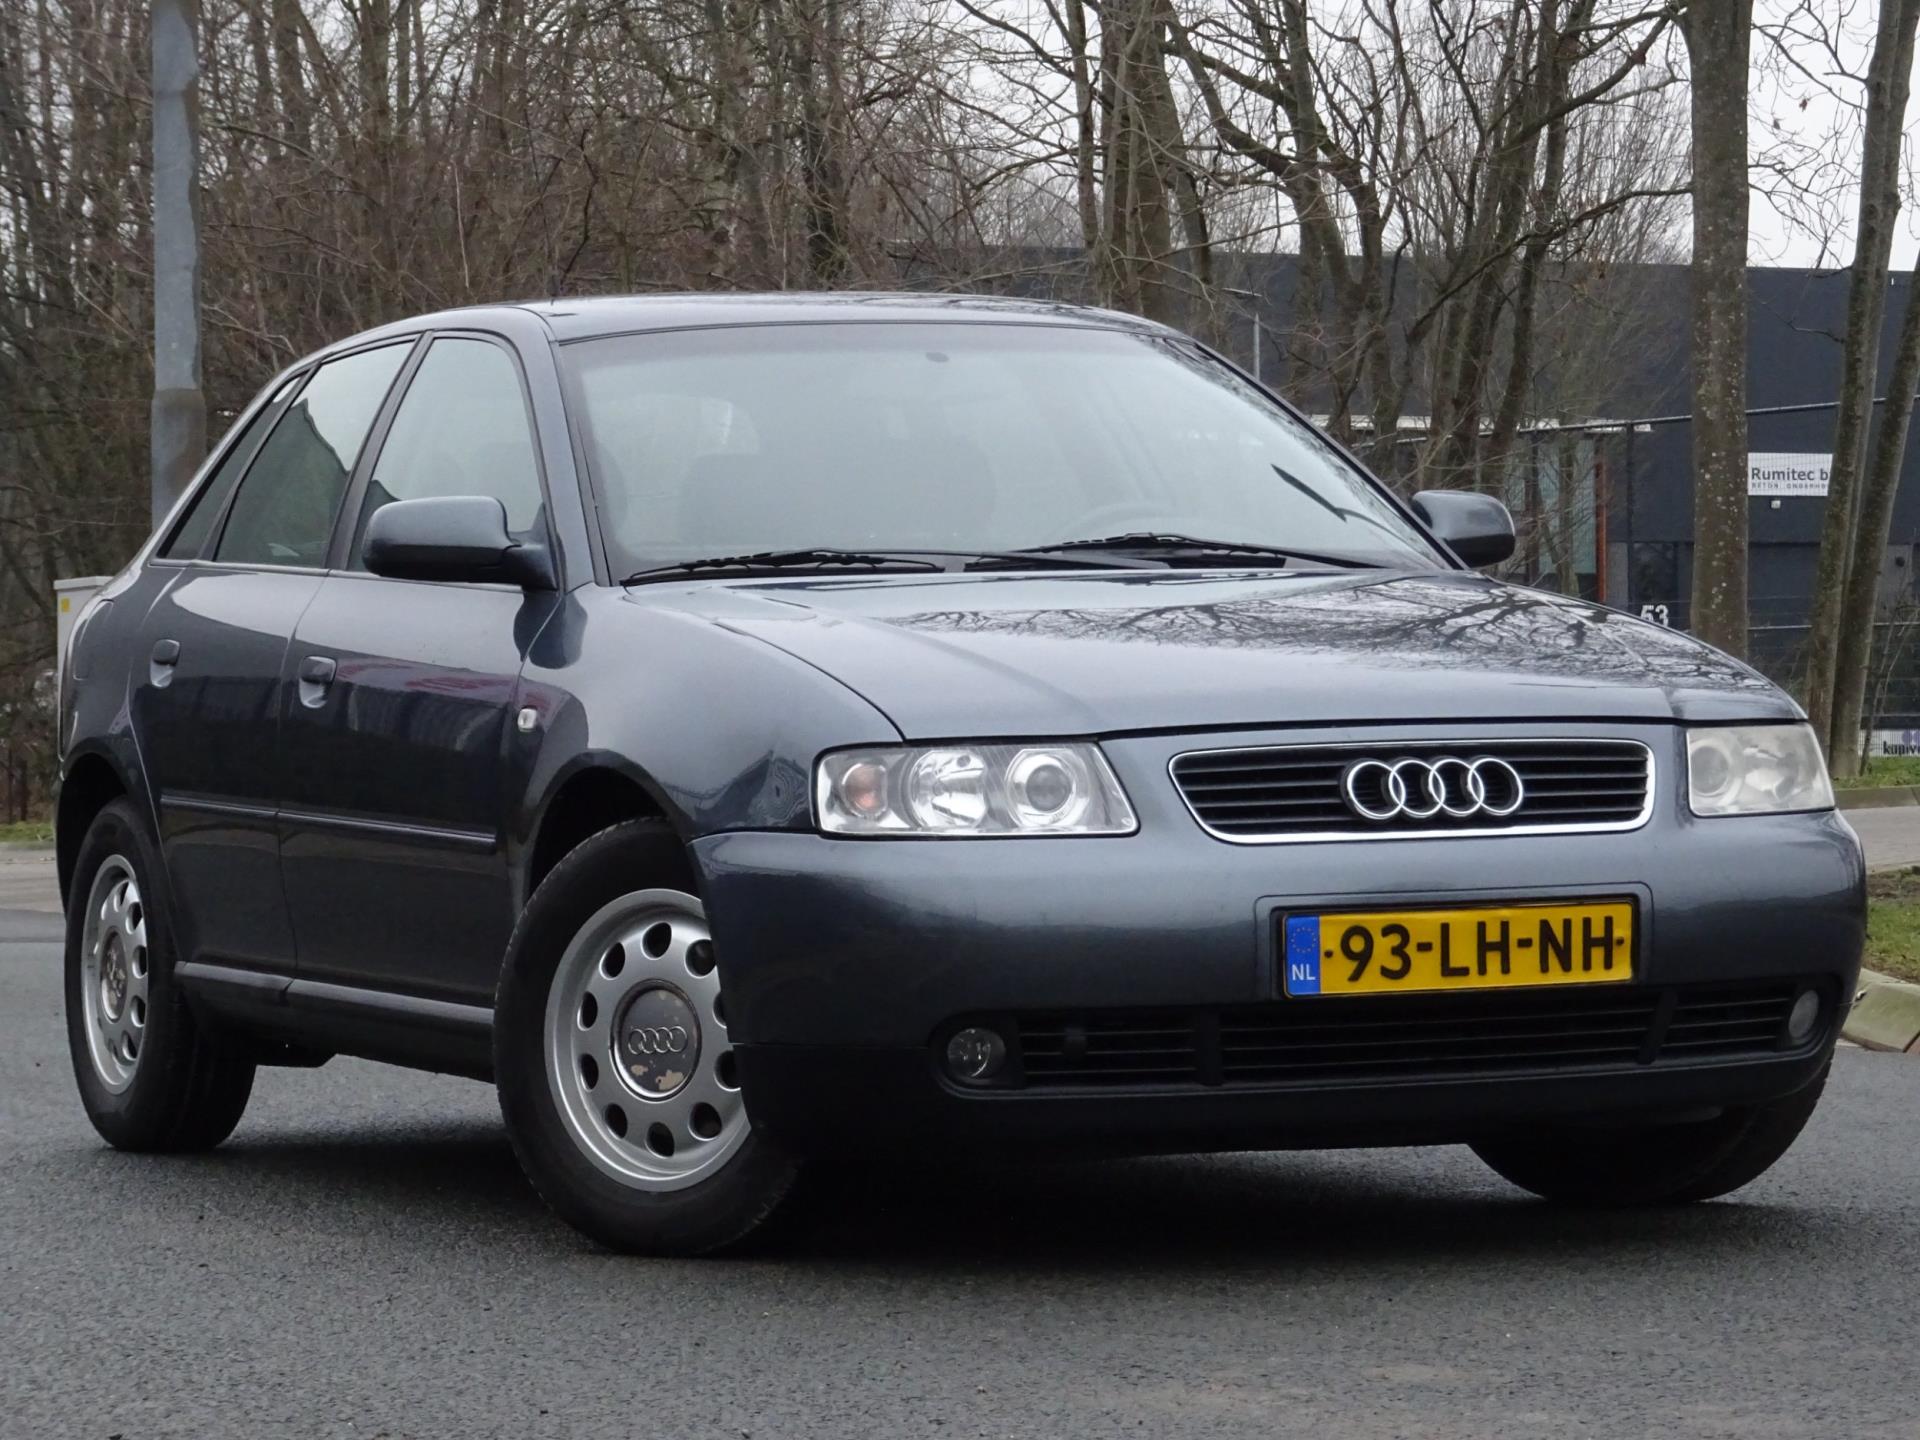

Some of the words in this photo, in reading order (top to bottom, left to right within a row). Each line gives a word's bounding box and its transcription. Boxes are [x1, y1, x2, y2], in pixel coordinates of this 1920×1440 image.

[1751, 467, 1815, 481] Rumitec
[1820, 468, 1831, 481] b
[1640, 604, 1669, 627] 53
[1339, 915, 1614, 982] 93-LH-NH
[1292, 963, 1316, 981] NL
